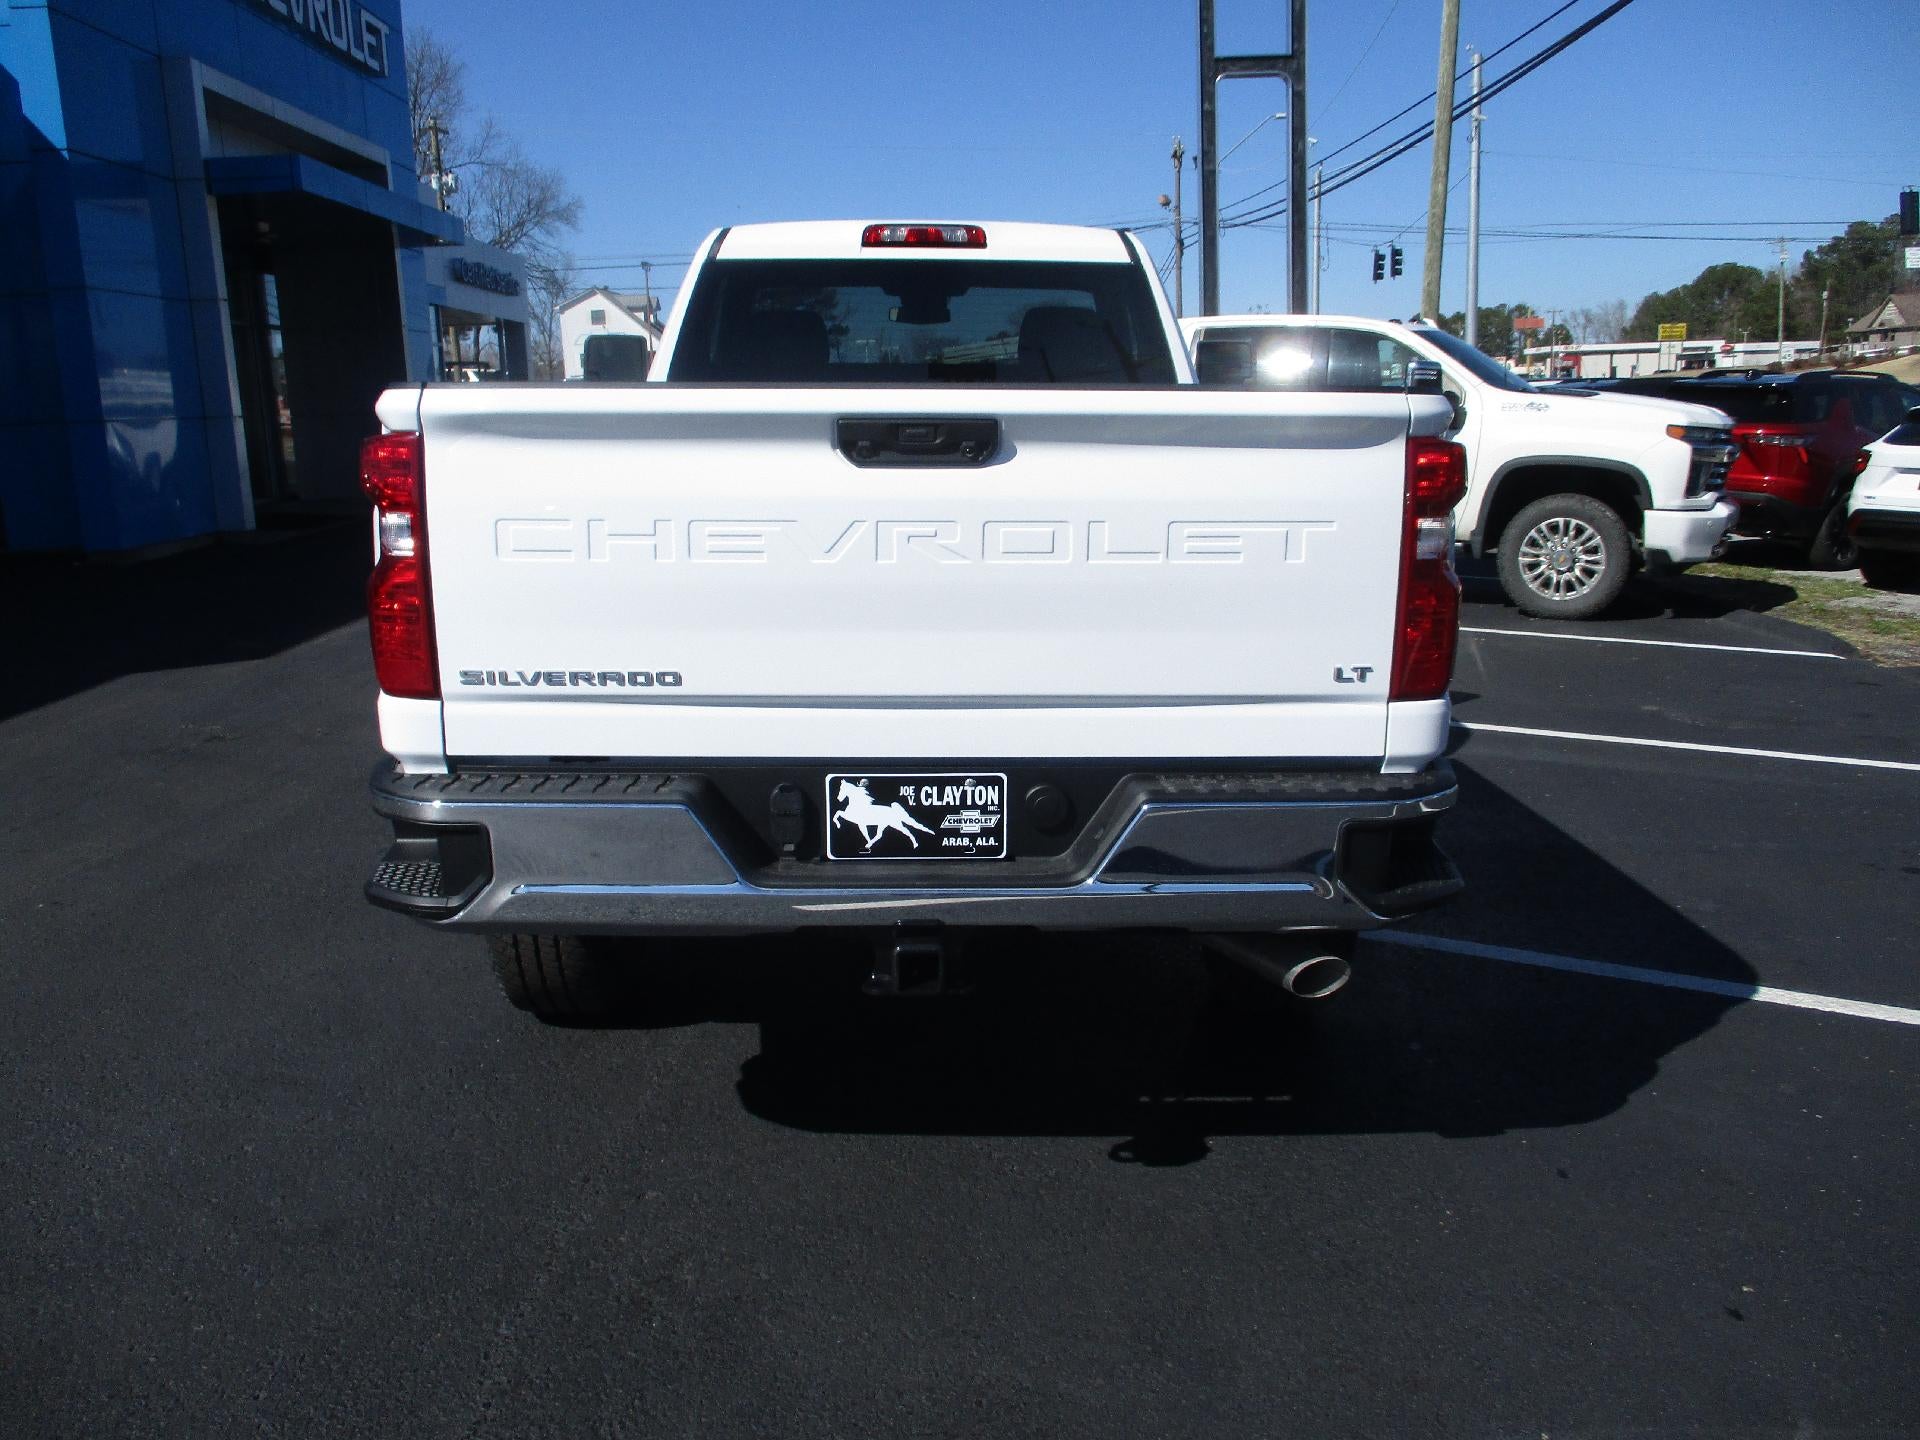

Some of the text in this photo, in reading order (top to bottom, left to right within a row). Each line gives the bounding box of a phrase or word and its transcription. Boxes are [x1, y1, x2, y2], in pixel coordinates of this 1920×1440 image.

[262, 0, 390, 77] VROLET
[494, 517, 1338, 564] CHEVROLET
[459, 669, 683, 687] SILVERADO
[1333, 664, 1374, 683] LT
[899, 785, 999, 806] JOE CLAYTON
[907, 796, 916, 806] V.
[947, 817, 993, 825] CHEVROLET
[942, 837, 999, 847] ARAB, ALA.
